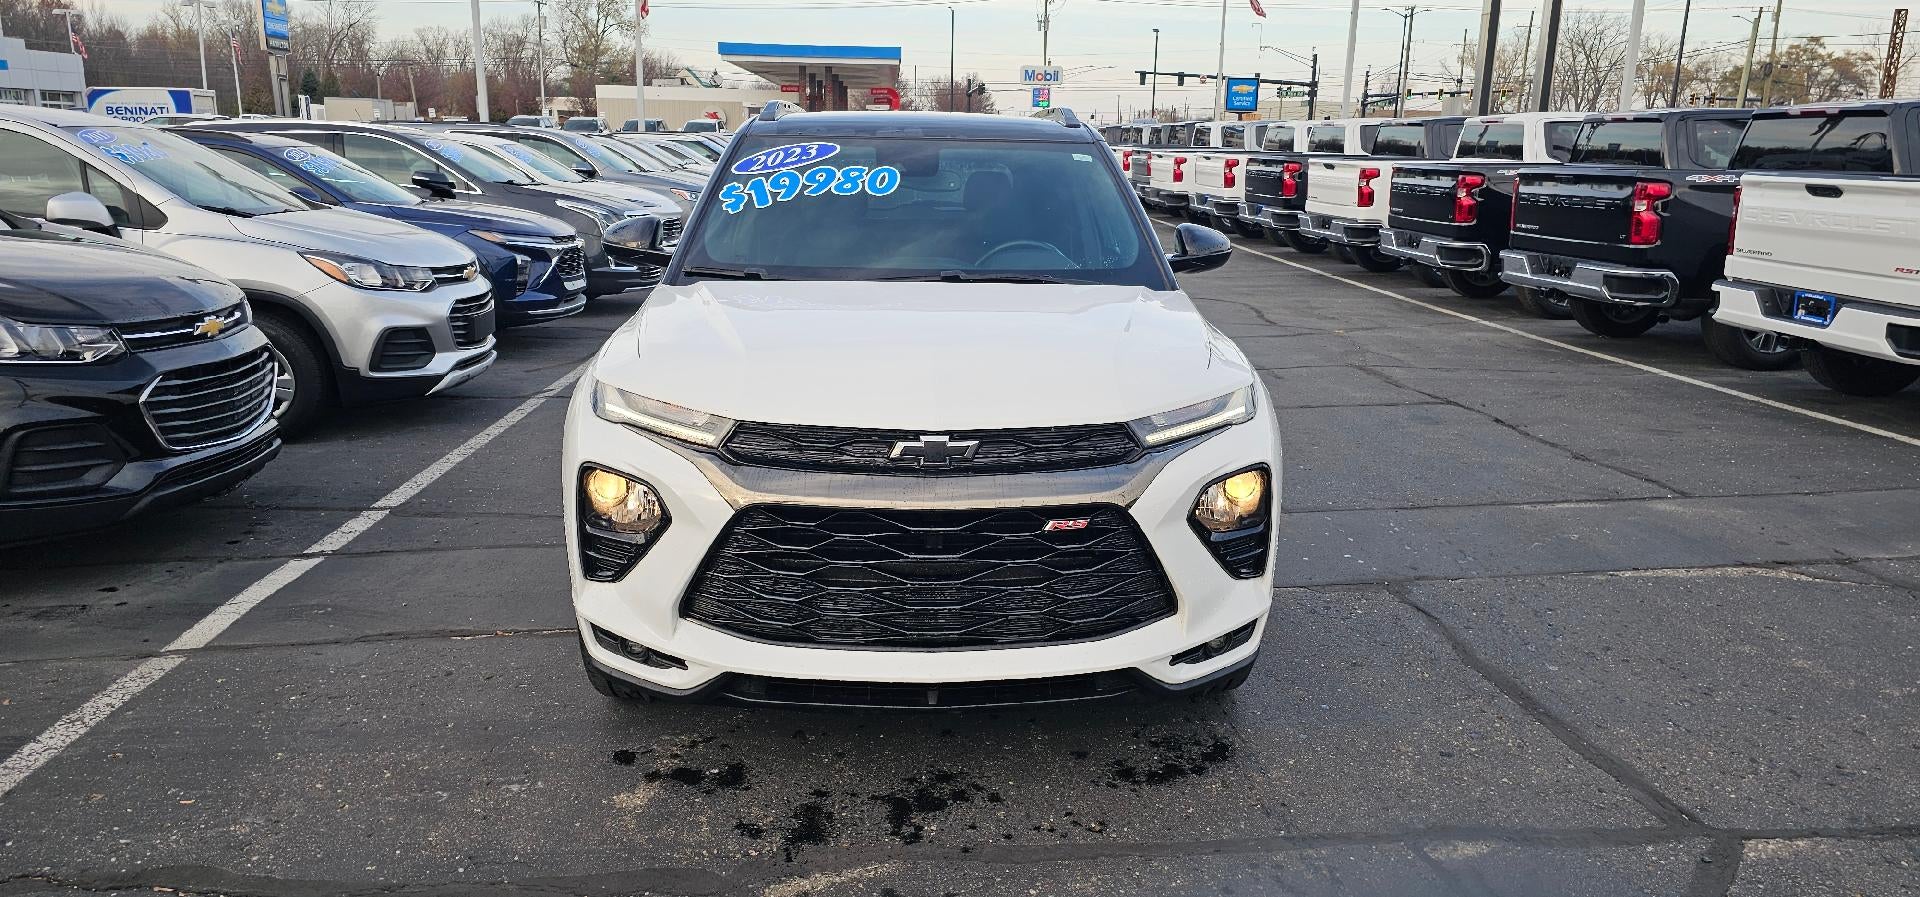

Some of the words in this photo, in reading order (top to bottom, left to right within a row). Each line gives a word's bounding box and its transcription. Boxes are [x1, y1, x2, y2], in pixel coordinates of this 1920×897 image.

[1024, 69, 1059, 82] Mobil
[106, 105, 169, 116] BENINATI
[748, 144, 819, 172] 2023
[719, 165, 901, 214] $19980
[1043, 519, 1091, 532] RS
